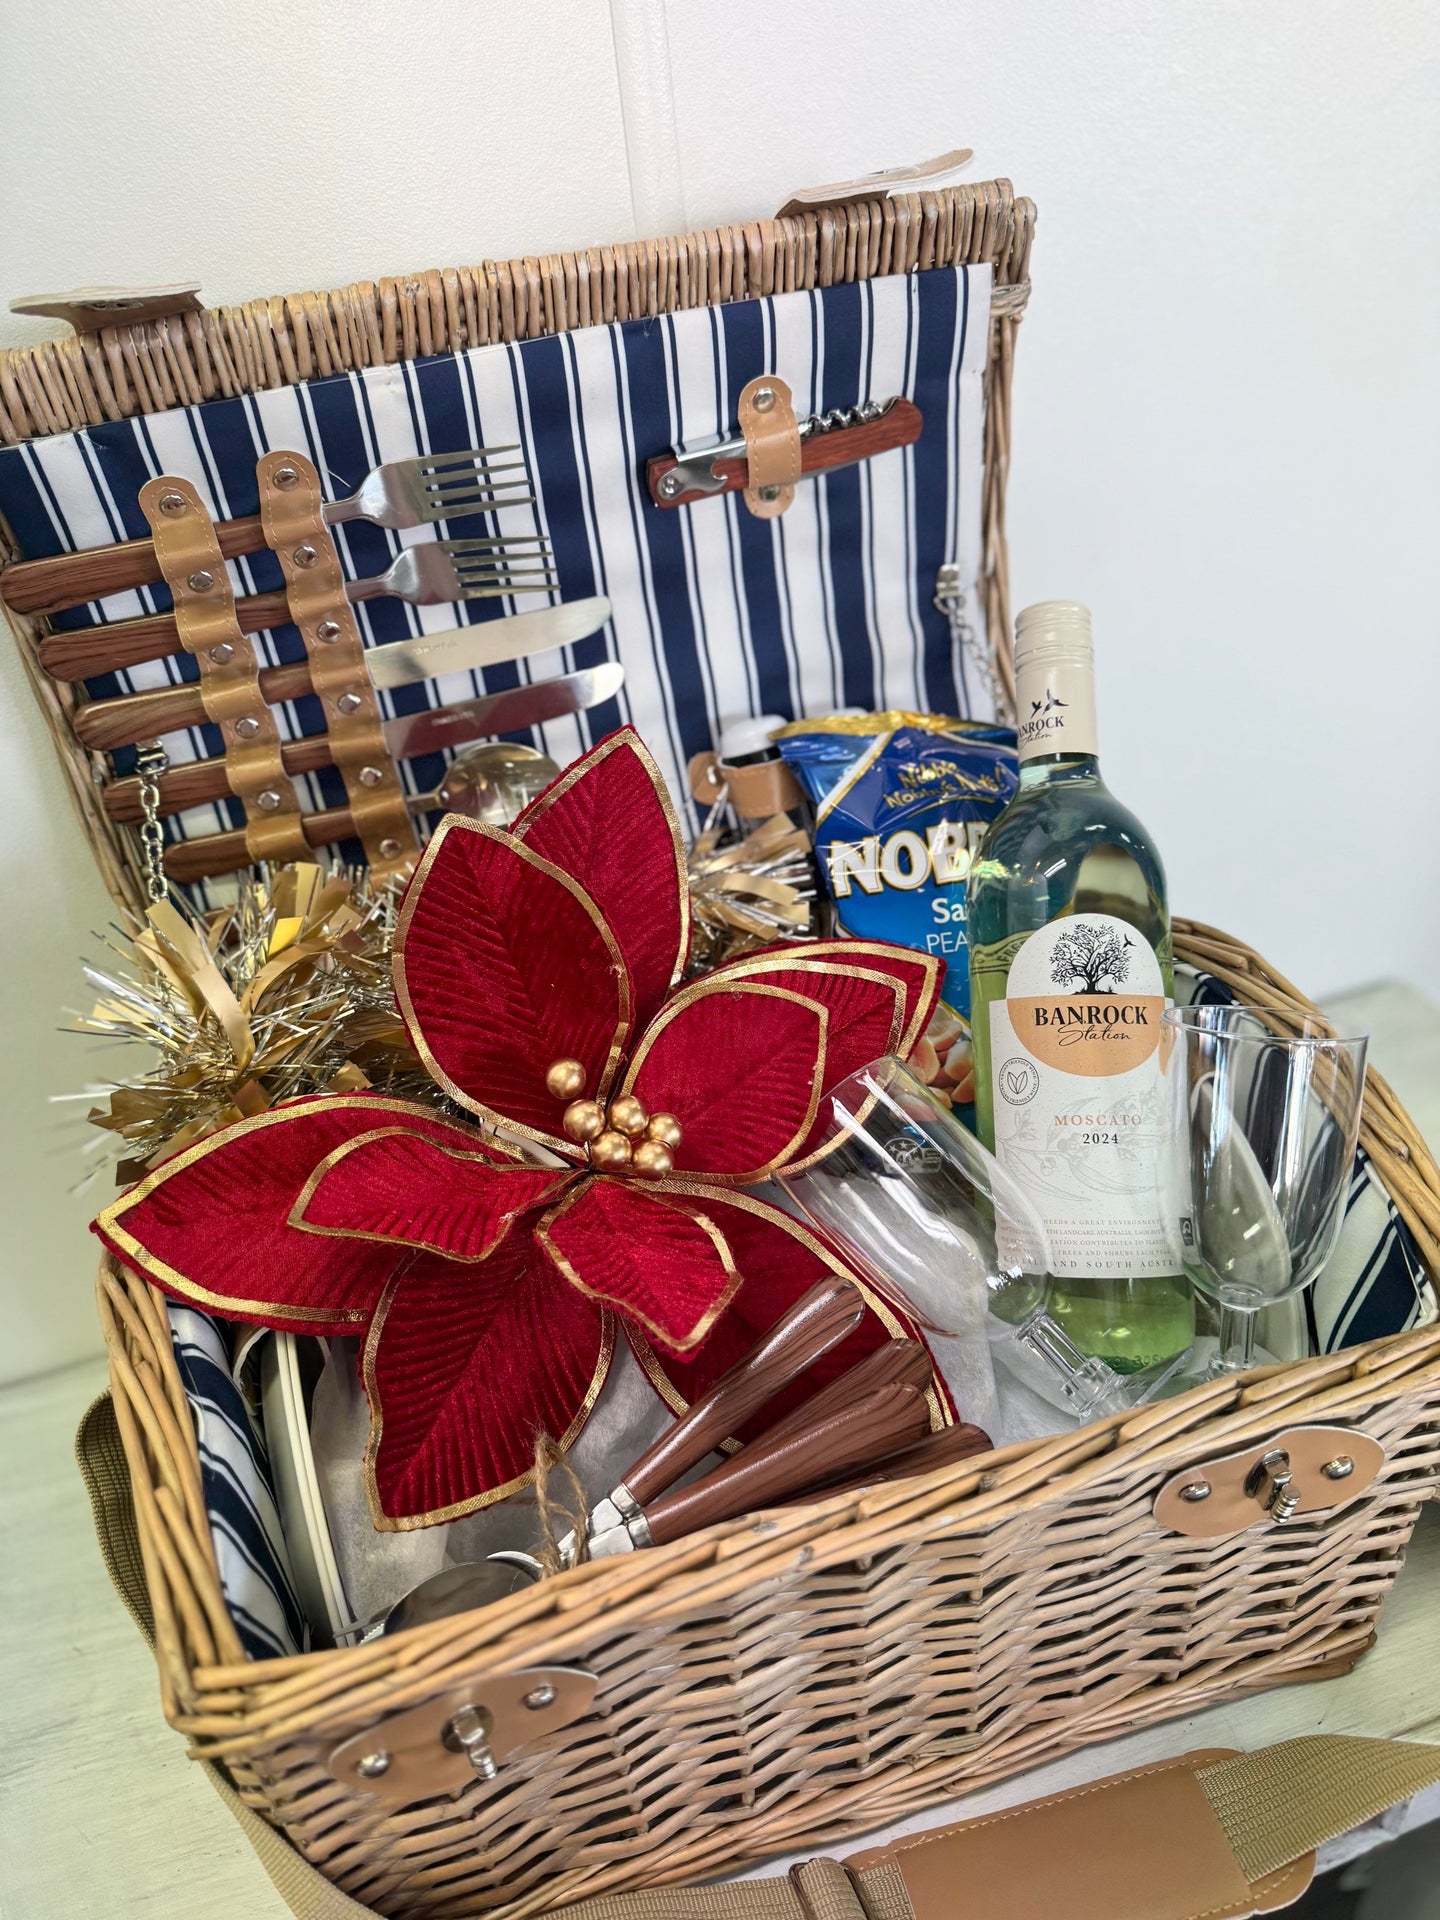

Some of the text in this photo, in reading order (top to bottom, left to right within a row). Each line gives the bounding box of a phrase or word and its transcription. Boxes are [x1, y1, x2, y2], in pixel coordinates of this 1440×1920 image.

[931, 897, 967, 924] Sa
[1034, 1005, 1148, 1026] BANROCK
[1057, 1019, 1132, 1046] Station
[1054, 1114, 1142, 1126] MOSCATO
[1082, 1133, 1119, 1144] 2024
[1086, 1260, 1132, 1268] SOUTH
